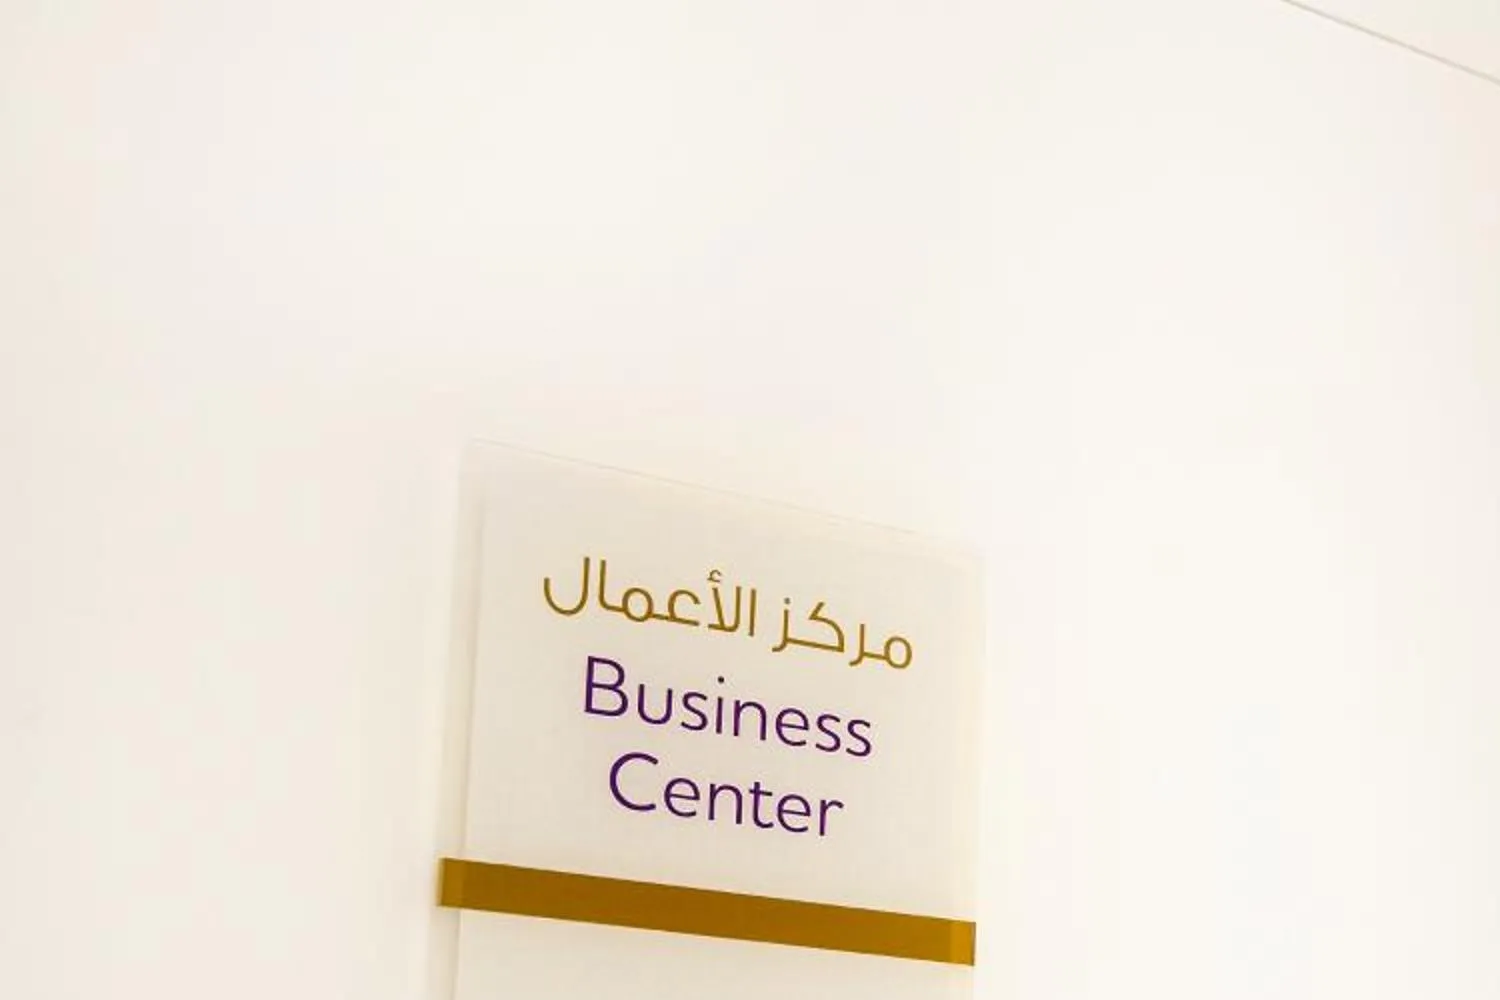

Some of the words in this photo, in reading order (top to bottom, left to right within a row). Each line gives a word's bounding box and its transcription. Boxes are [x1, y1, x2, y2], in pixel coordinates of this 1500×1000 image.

[542, 555, 758, 639] الأعمال
[769, 595, 914, 671] مركز
[582, 654, 874, 759] Business
[607, 750, 846, 838] Center
